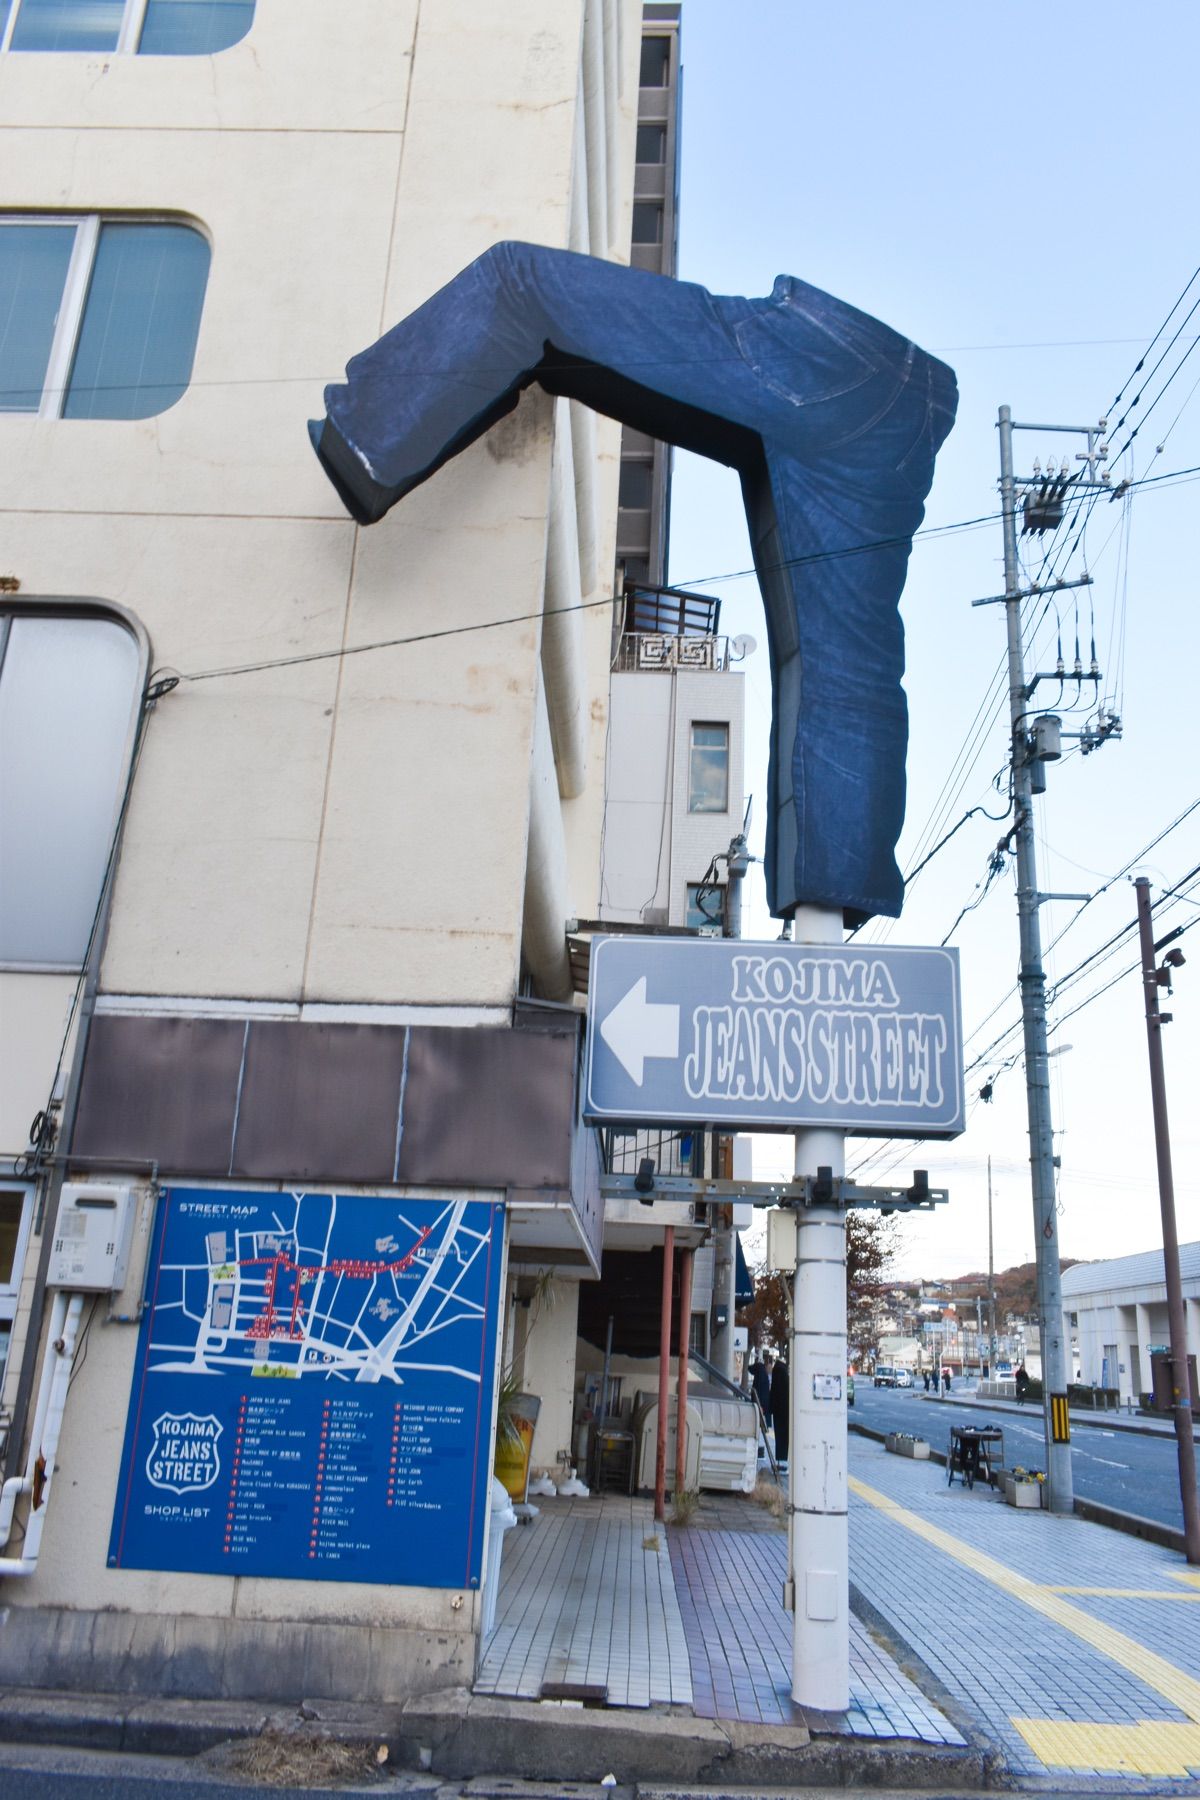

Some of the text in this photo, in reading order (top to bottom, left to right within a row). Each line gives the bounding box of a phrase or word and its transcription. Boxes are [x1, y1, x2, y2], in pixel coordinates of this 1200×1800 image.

[731, 956, 900, 1007] KOJIMA
[684, 1006, 947, 1108] JEANS STREET
[179, 1202, 259, 1215] STREET MAP
[161, 1420, 215, 1437] KOJIMA
[161, 1439, 211, 1461] JEANS
[152, 1460, 214, 1482] STREET
[144, 1504, 211, 1518] SHOP LIST
